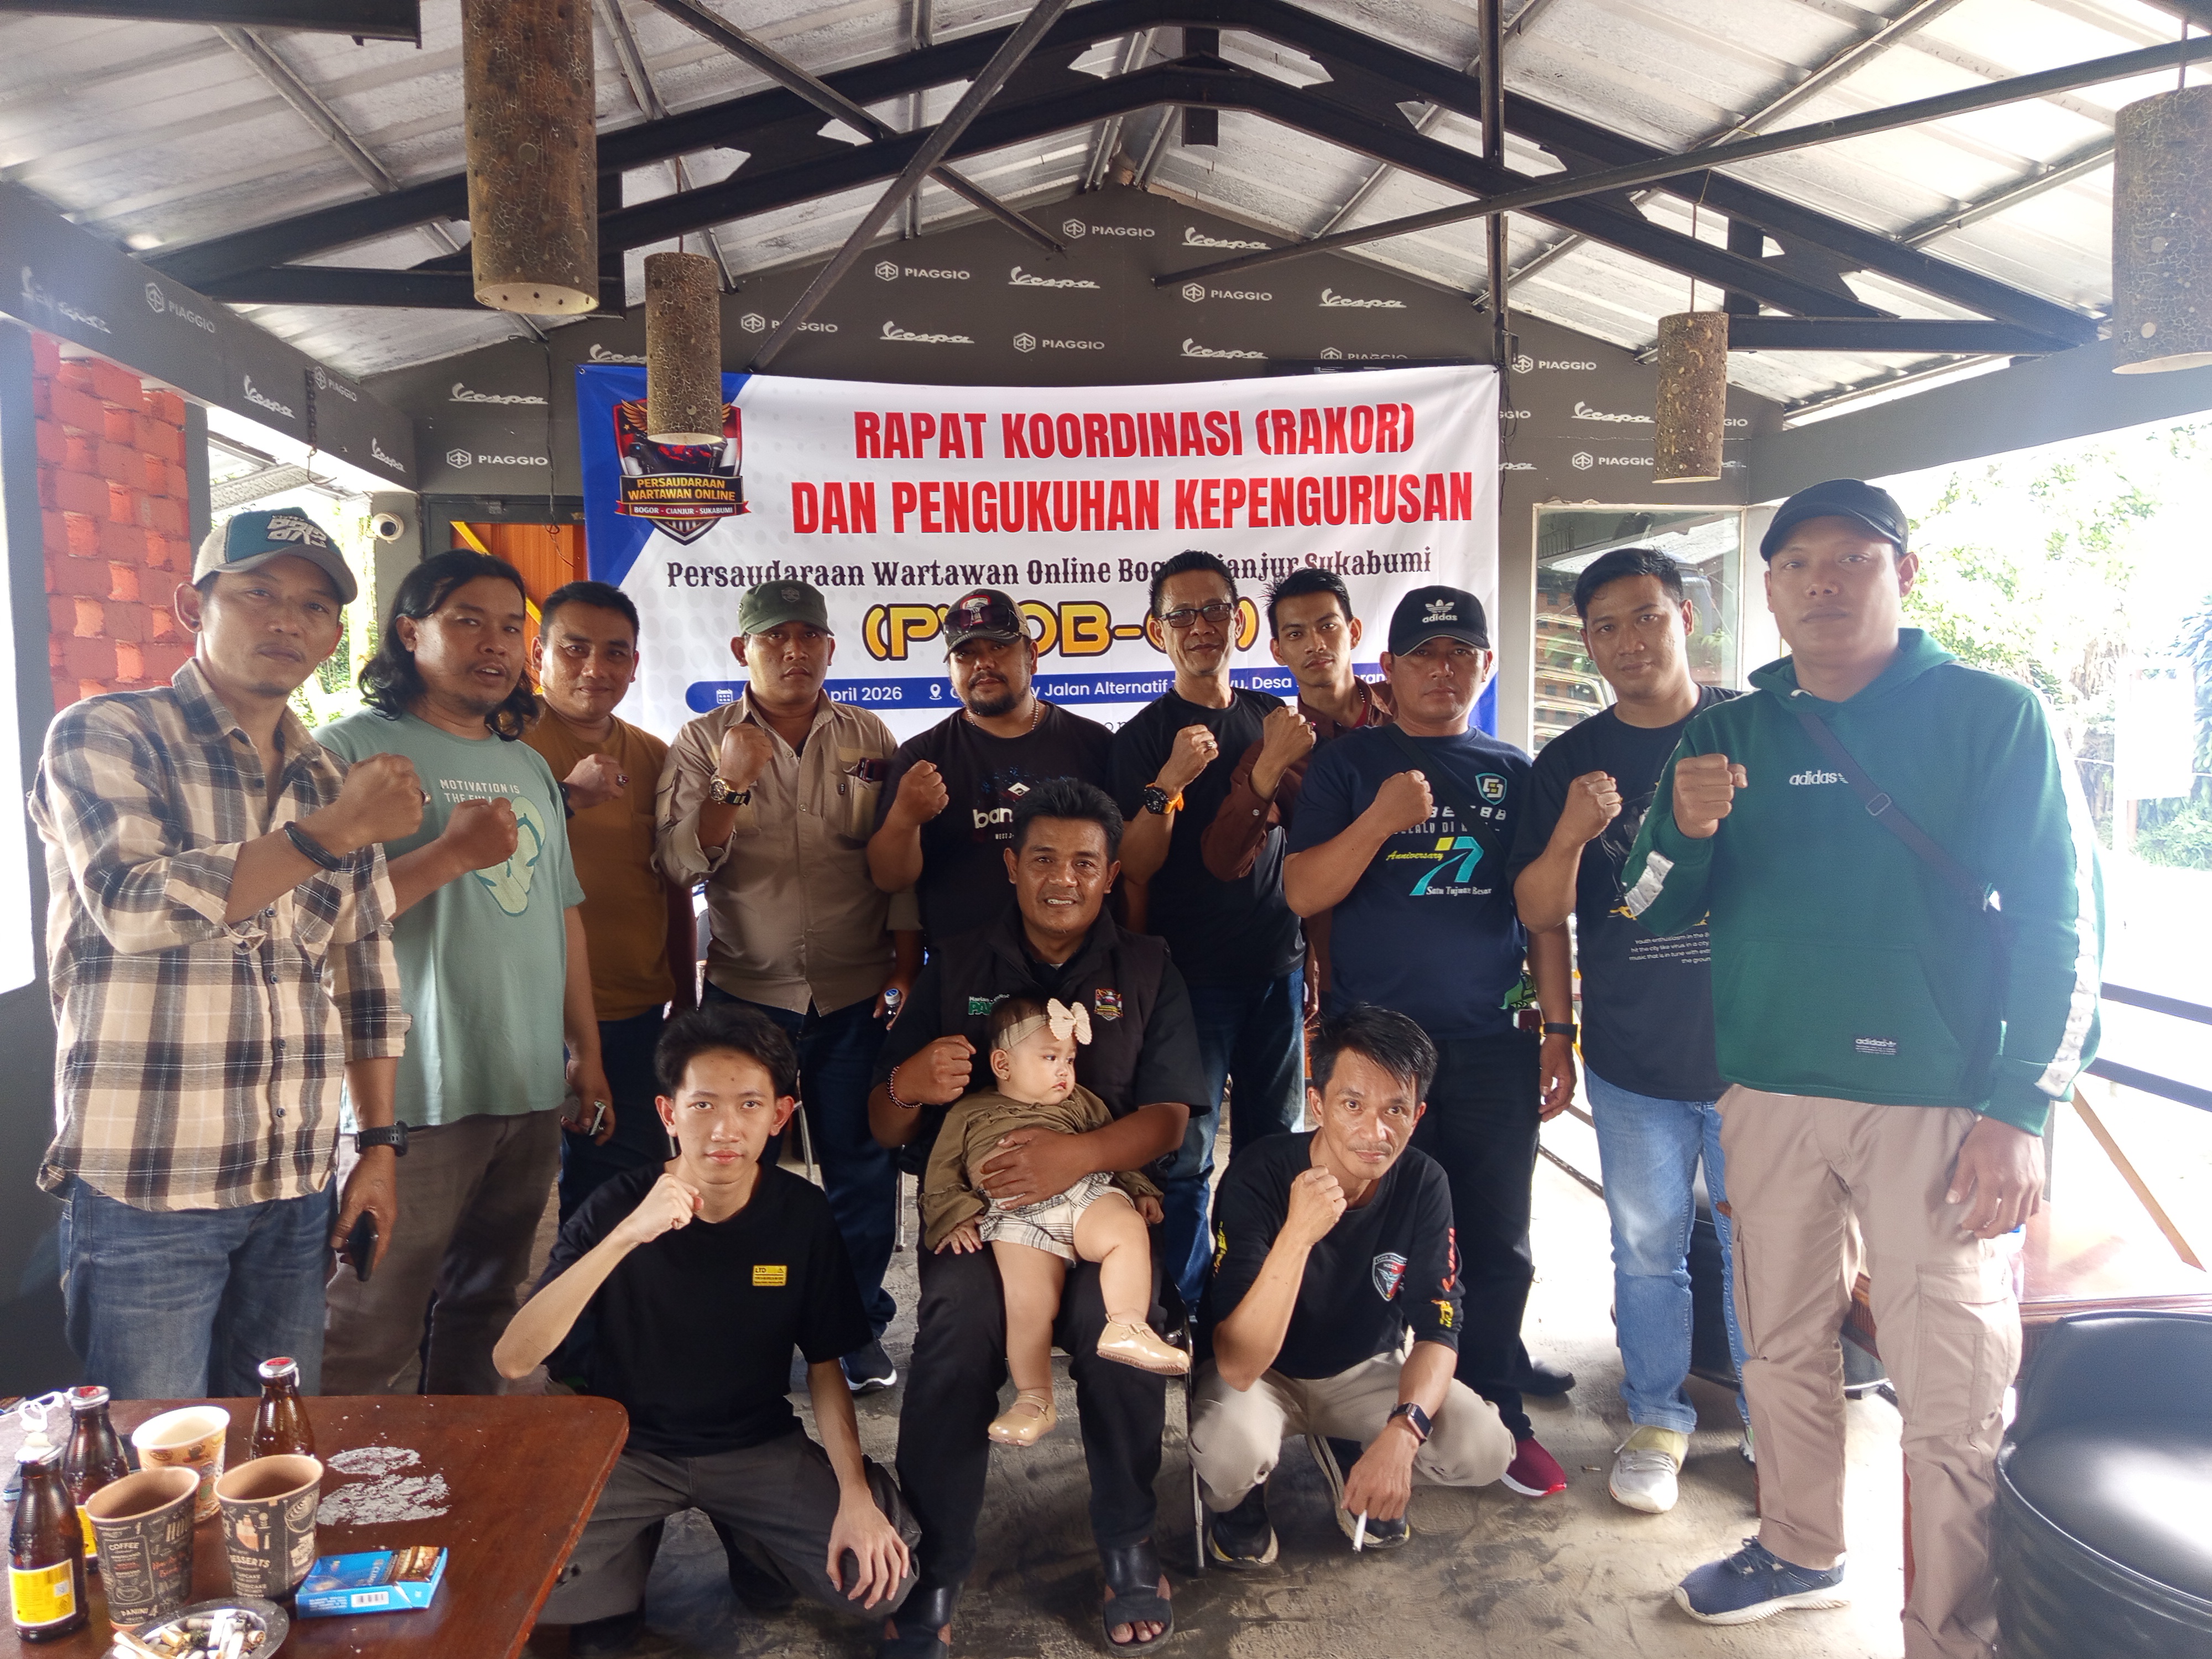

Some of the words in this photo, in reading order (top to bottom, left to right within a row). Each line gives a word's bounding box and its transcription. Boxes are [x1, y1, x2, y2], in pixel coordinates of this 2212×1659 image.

[1092, 226, 1155, 237] PIAGGIO
[1182, 227, 1272, 249] Vespa
[905, 268, 970, 279] PIAGGIO
[1008, 266, 1100, 288] Vespa
[1211, 290, 1272, 301] PIAGGIO
[1319, 288, 1406, 308] Vespa
[168, 300, 215, 333] PIAGGIO
[771, 320, 838, 332] PGGIO
[880, 321, 975, 343] Vespa
[1042, 340, 1105, 349] PIAGGIO
[1180, 338, 1269, 359] Vespa
[1538, 361, 1597, 371] PIAGGIO
[244, 375, 295, 419] Vespa
[328, 379, 357, 401] PIAGGIO
[448, 382, 549, 404] Vespa
[1572, 401, 1655, 423] Vespa
[854, 411, 986, 459] RAPAT
[1001, 411, 1243, 458] KOORDINASI
[1256, 403, 1414, 456] (RAKOR)
[371, 437, 406, 473] Vespa
[478, 455, 549, 466] PIAGGIO
[637, 477, 726, 489] PERSAUDARAAN
[628, 488, 691, 500] WARTAWAN
[695, 489, 735, 501] ONLINE
[792, 482, 876, 534] DAN
[891, 480, 1159, 534] PENGUKUHAN
[1175, 472, 1472, 530] KEPENGURUSAN
[667, 560, 865, 587] Persaudaraan
[872, 559, 1018, 586] Wartawan
[1027, 557, 1112, 584] Online
[1305, 546, 1431, 576] Sukabumi
[1422, 613, 1458, 623] adidas
[823, 687, 857, 701] pril
[862, 686, 902, 700] 2026
[1045, 682, 1090, 696] Jalan
[1094, 679, 1168, 695] Alternatif
[1253, 676, 1292, 690] Desa
[1789, 770, 1838, 785] adidas
[440, 779, 508, 793] MOTIVATION
[510, 784, 520, 794] IS
[444, 793, 465, 803] THE
[1386, 850, 1444, 861] Anniversary
[1426, 886, 1444, 895] Satu
[1446, 885, 1472, 896] Tujuan
[1472, 886, 1492, 895] Besar
[1855, 1037, 1887, 1046] adidas
[108, 1542, 139, 1551] COFFEE
